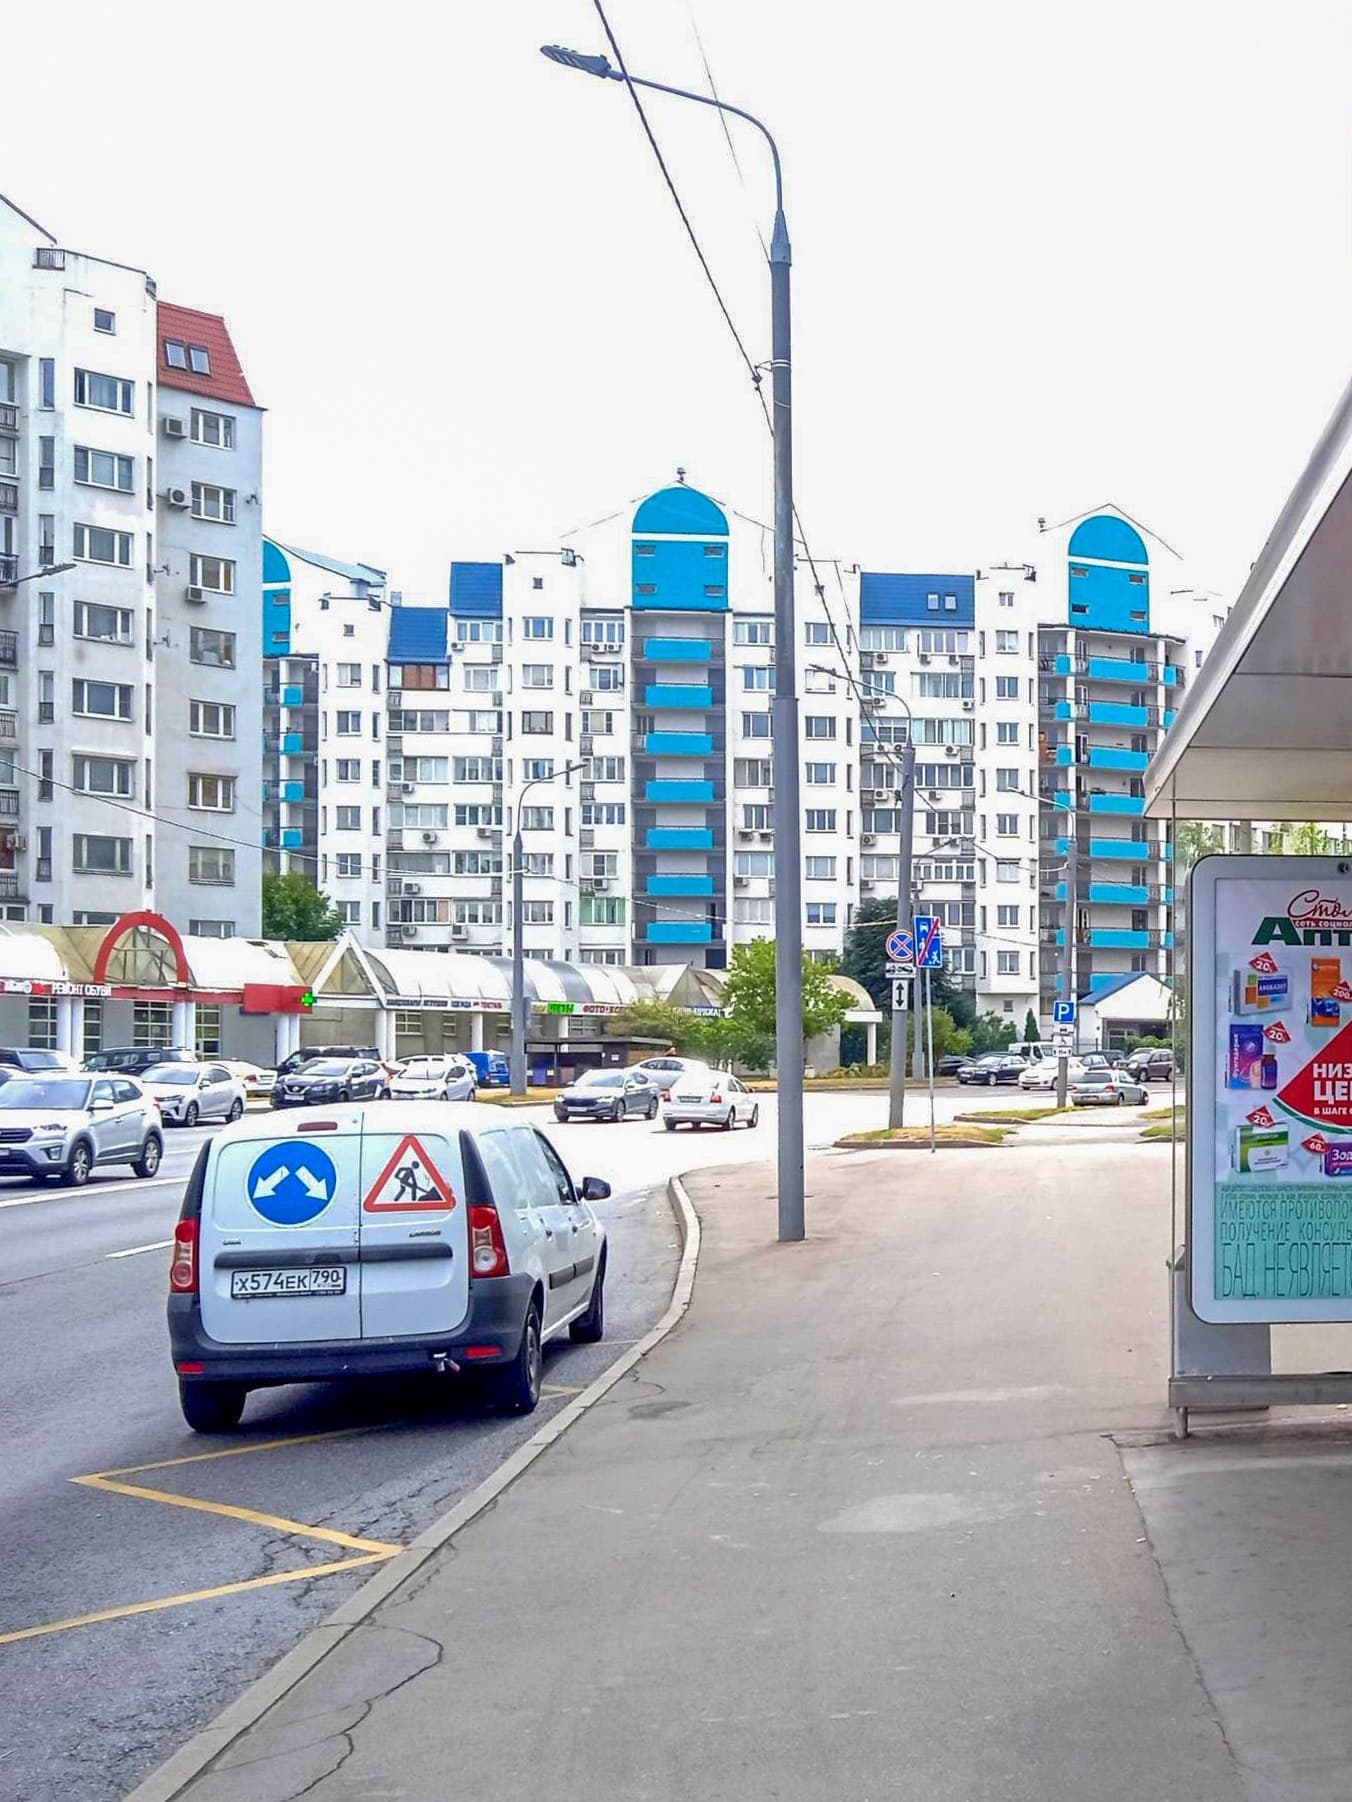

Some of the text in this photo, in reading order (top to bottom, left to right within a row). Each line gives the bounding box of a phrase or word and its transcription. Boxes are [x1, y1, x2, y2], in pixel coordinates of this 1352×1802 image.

[1296, 920, 1316, 928] сеть
[1058, 1003, 1070, 1020] P
[1314, 1107, 1320, 1115] В
[1322, 1107, 1348, 1115] ШАГЕ
[1220, 1200, 1276, 1220] ИМЕЮТСЯ
[1220, 1222, 1290, 1240] ПОЛУЧЕНИЕ
[312, 1270, 340, 1284] 790
